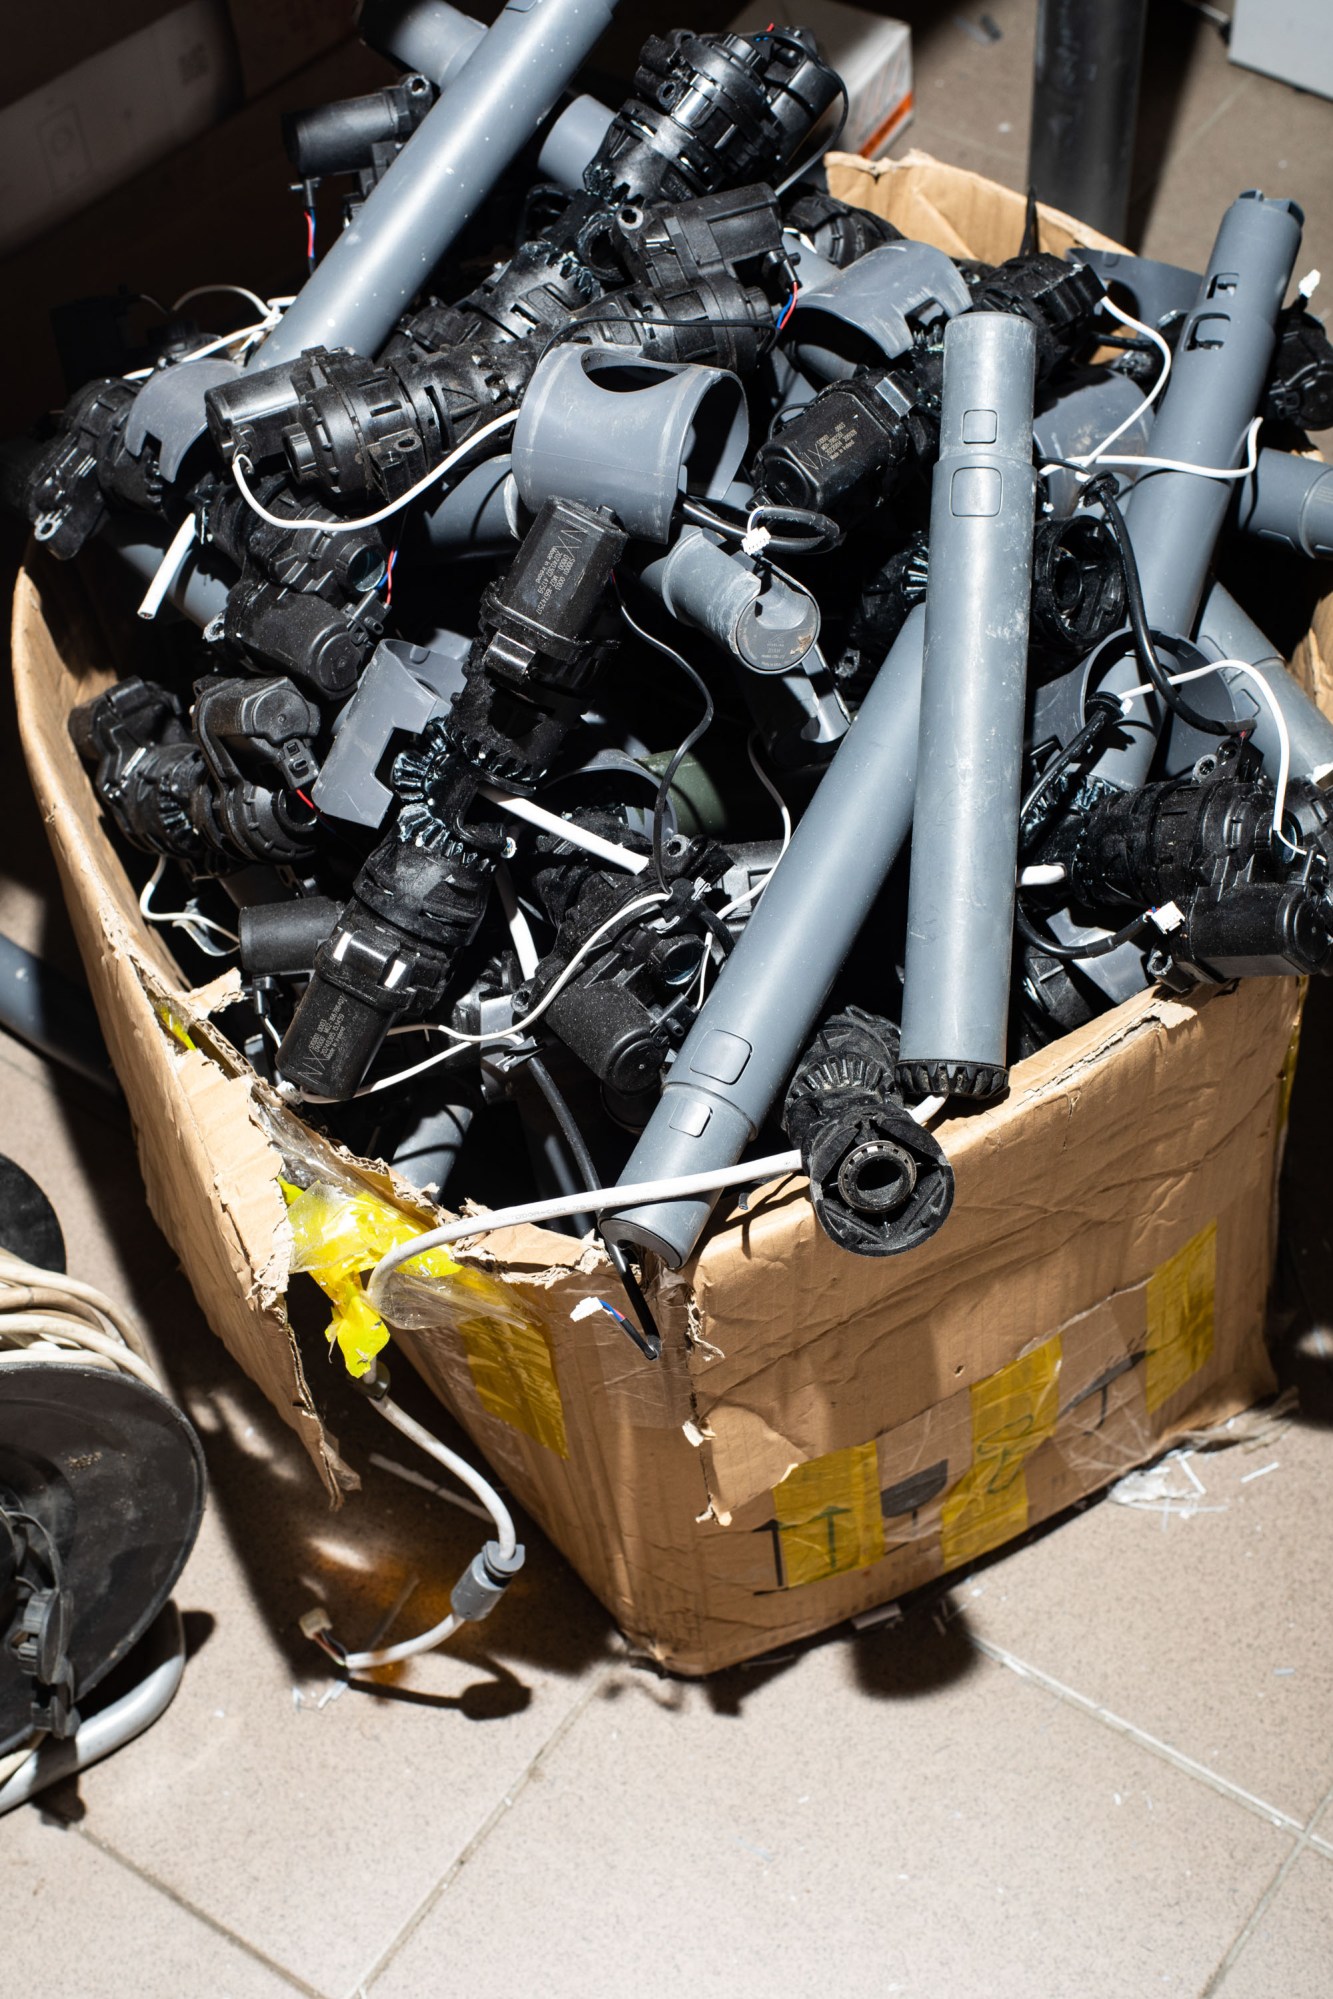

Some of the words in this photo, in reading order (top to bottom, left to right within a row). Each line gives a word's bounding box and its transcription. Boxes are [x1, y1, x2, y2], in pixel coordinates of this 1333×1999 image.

[552, 520, 588, 559] NX
[546, 546, 556, 560] Made
[534, 566, 546, 583] Ireland
[554, 576, 566, 590] 0003
[316, 1018, 326, 1032] 0003
[326, 1047, 335, 1059] Made
[334, 1025, 345, 1041] Ireland
[298, 1048, 330, 1084] NX
